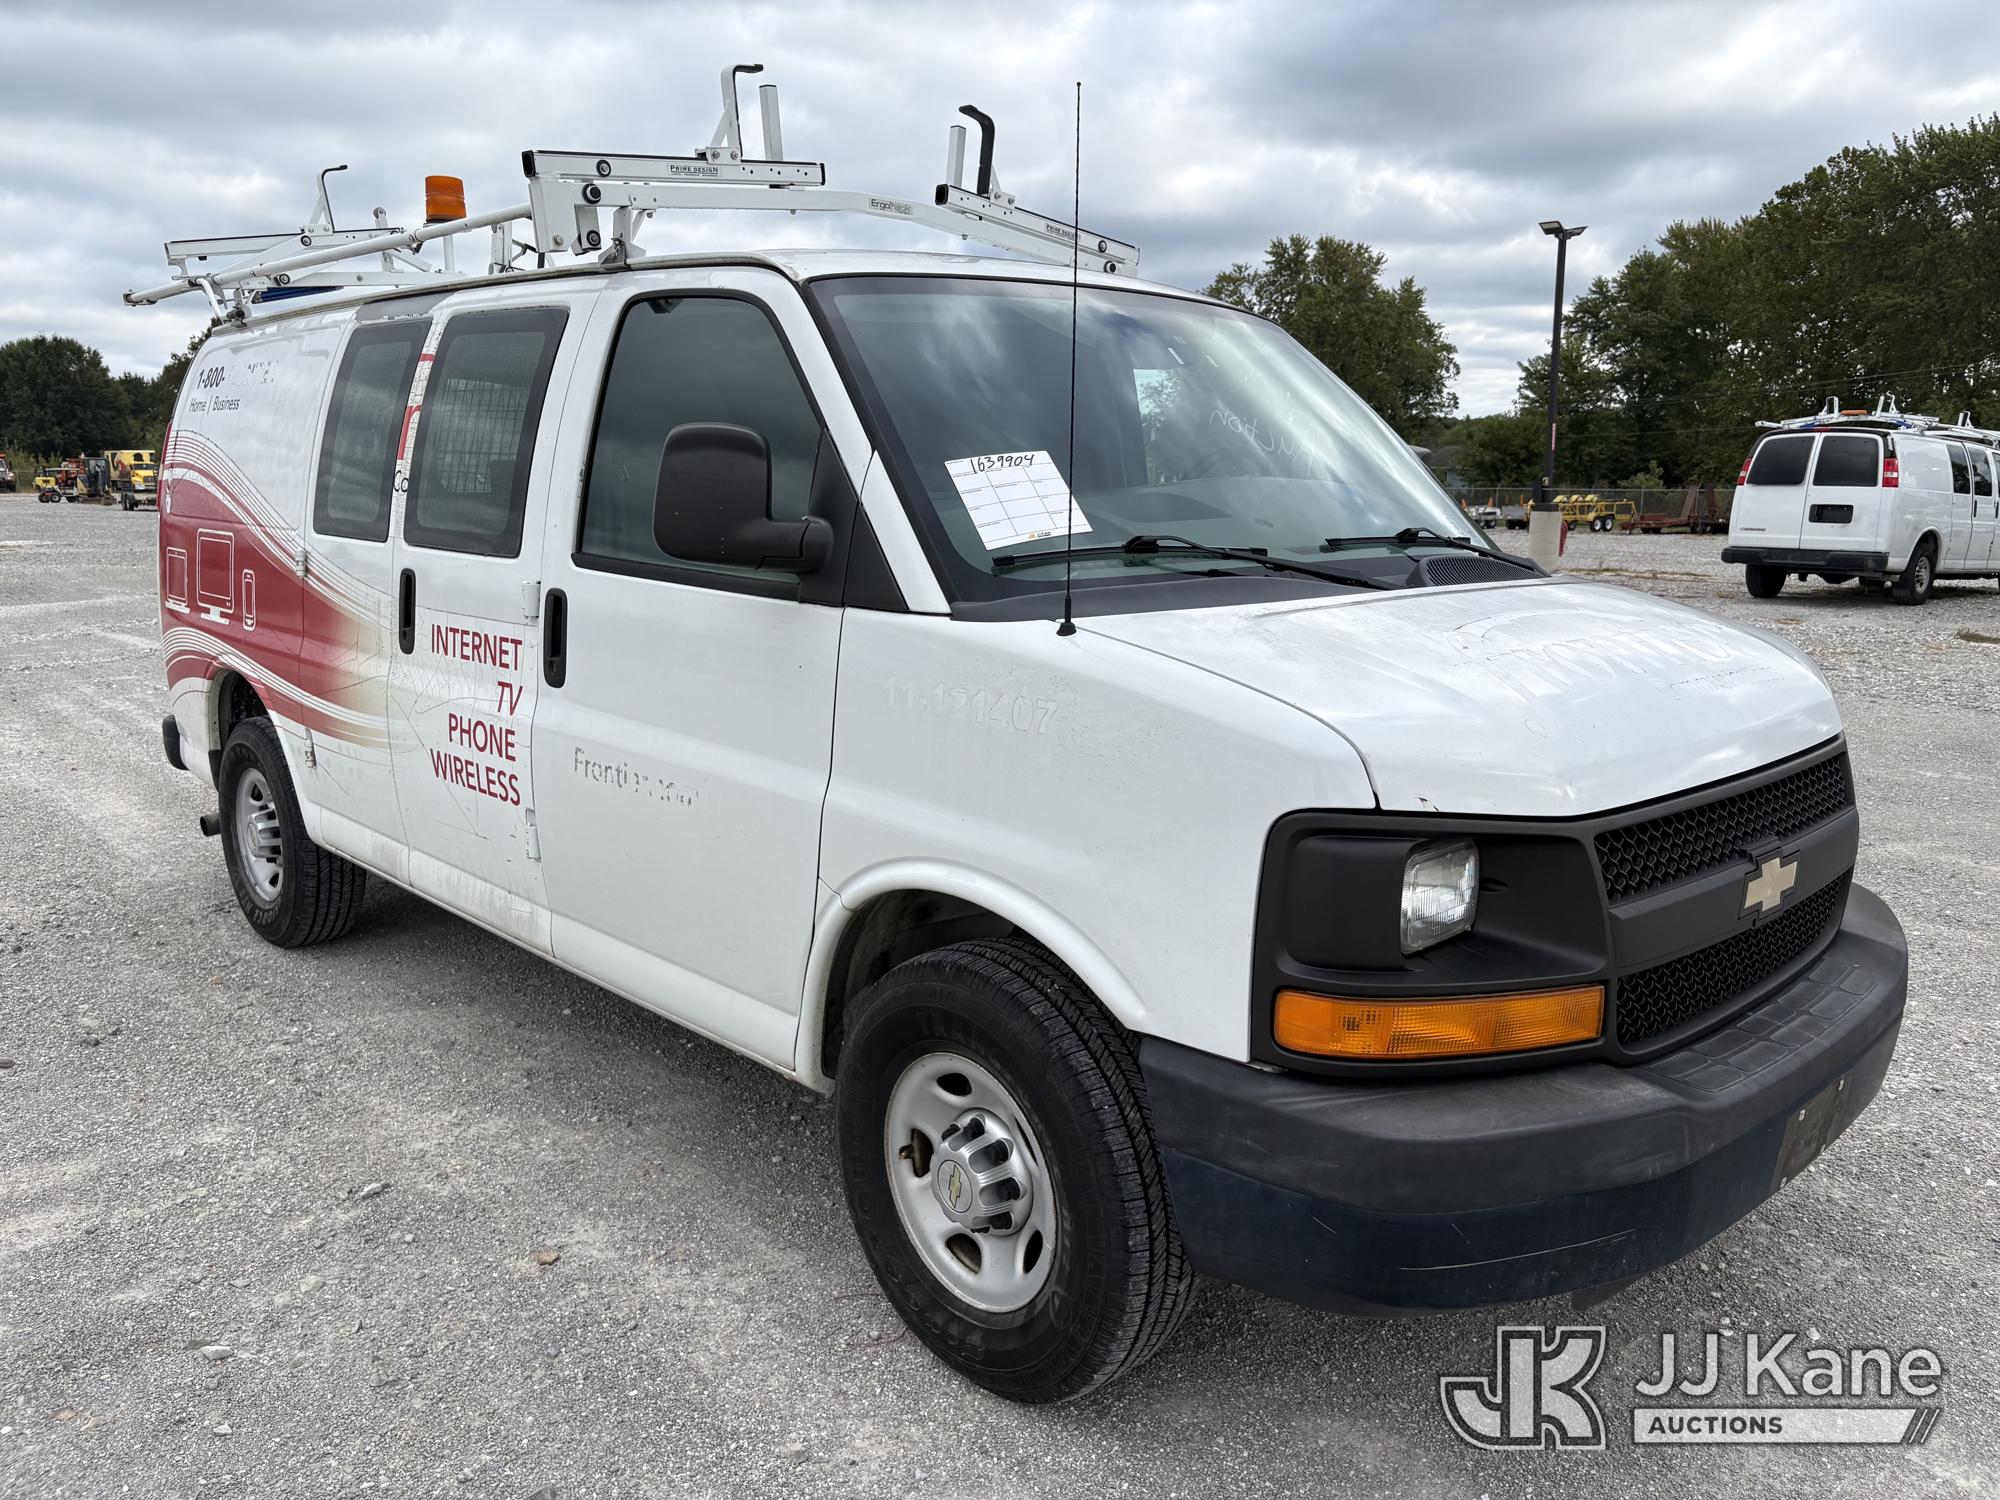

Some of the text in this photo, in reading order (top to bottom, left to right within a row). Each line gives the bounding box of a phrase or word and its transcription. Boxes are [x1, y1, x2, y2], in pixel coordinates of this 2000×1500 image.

[189, 395, 240, 413] Home Business
[970, 454, 1035, 475] 1639904
[431, 623, 523, 672] INTERNET
[497, 680, 523, 716] TV
[448, 712, 516, 762] PHONE
[430, 747, 520, 806] WIRELESS
